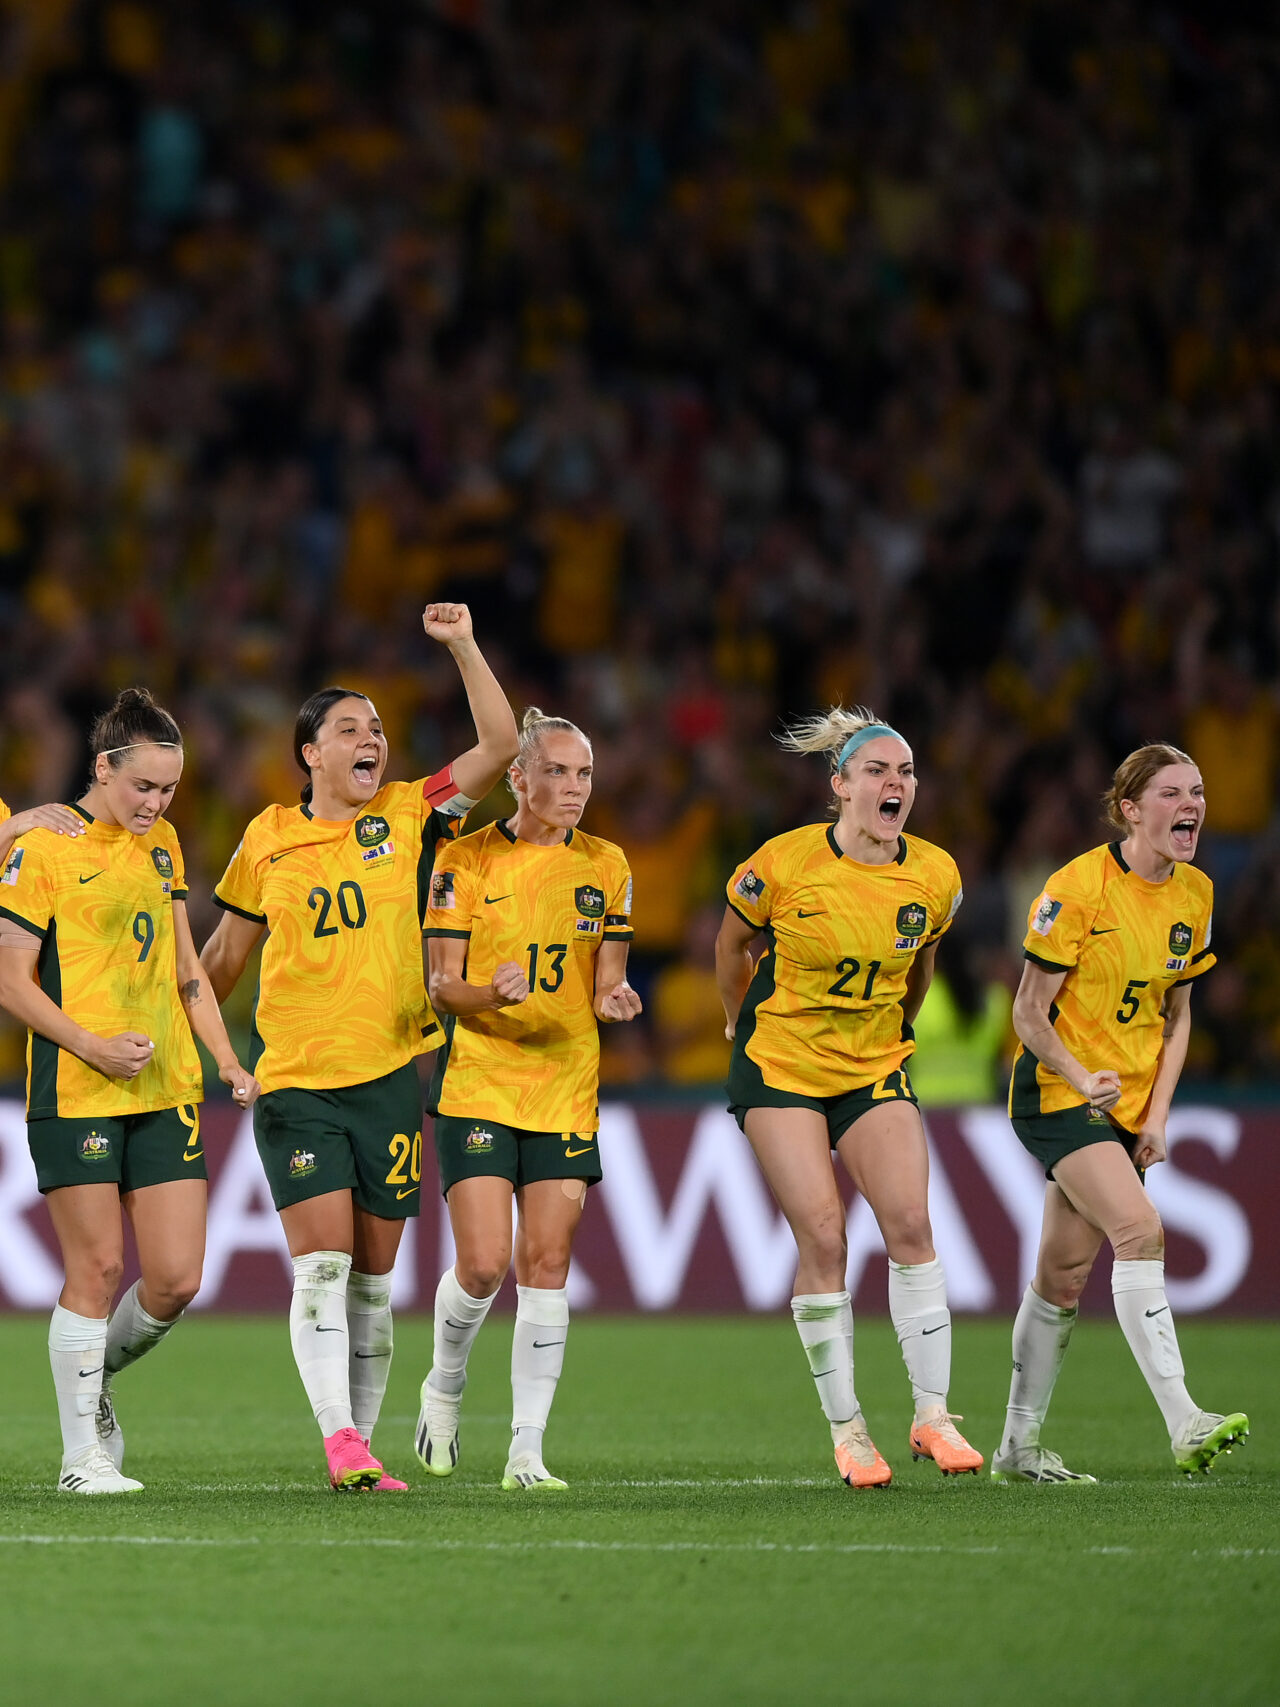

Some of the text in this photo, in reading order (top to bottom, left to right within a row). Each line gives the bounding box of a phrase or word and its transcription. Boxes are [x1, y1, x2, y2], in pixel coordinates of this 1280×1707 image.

[307, 880, 367, 939] 20
[132, 911, 155, 963] 9
[527, 943, 568, 993] 13
[826, 957, 882, 1001] 21
[1116, 979, 1150, 1024] 5
[176, 1103, 200, 1147] 9
[385, 1130, 423, 1184] 20
